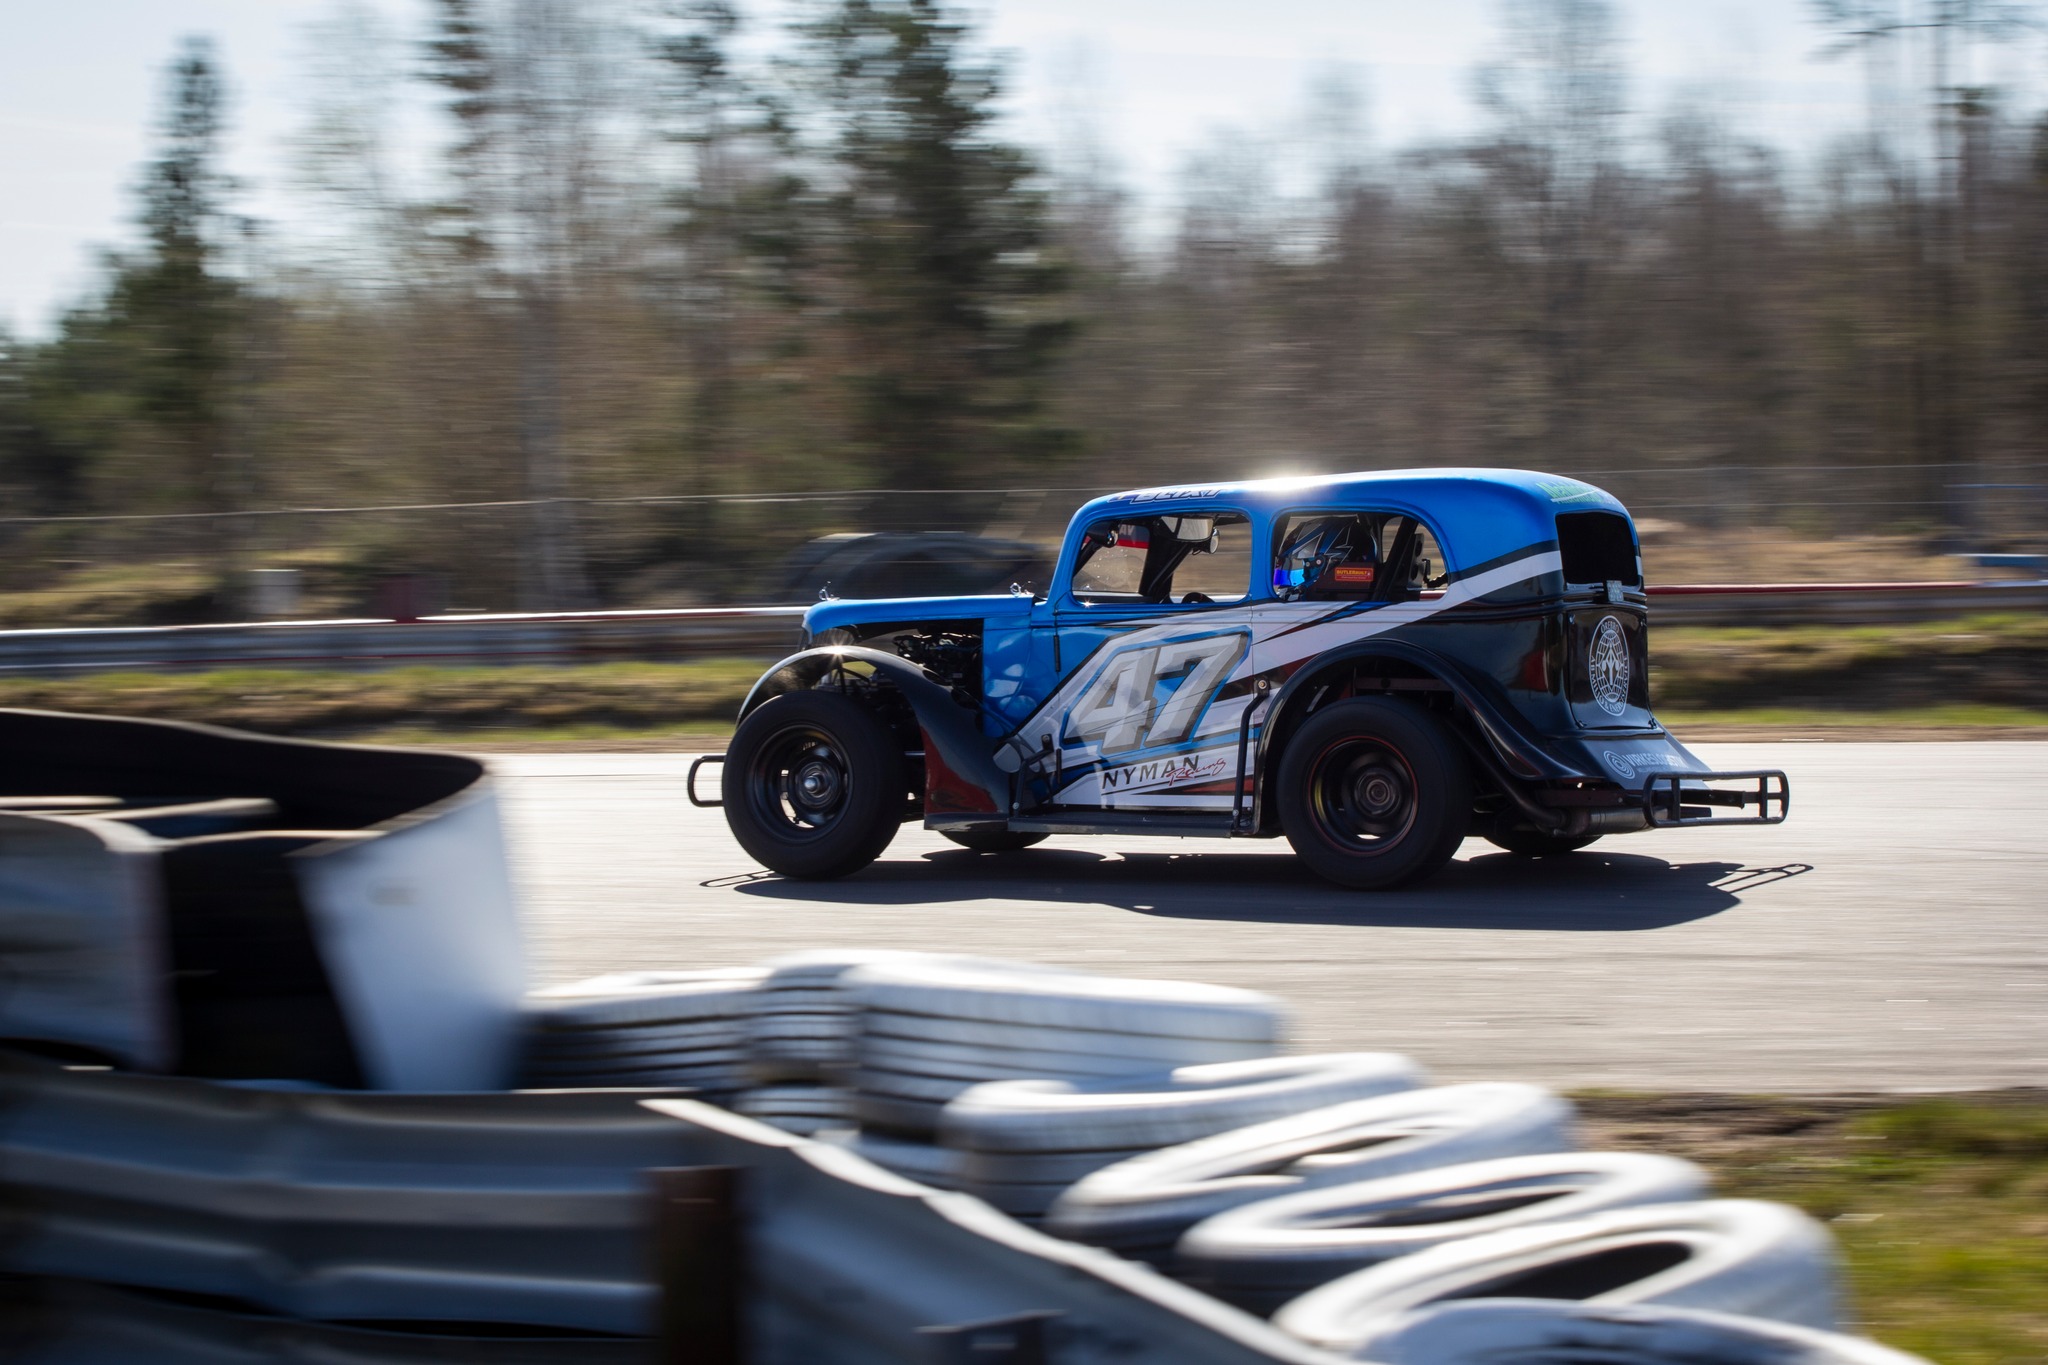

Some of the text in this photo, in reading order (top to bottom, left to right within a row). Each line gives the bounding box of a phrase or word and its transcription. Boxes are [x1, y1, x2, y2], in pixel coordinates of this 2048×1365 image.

[1063, 631, 1248, 754] 47
[1102, 754, 1227, 789] NYMAN Racing
